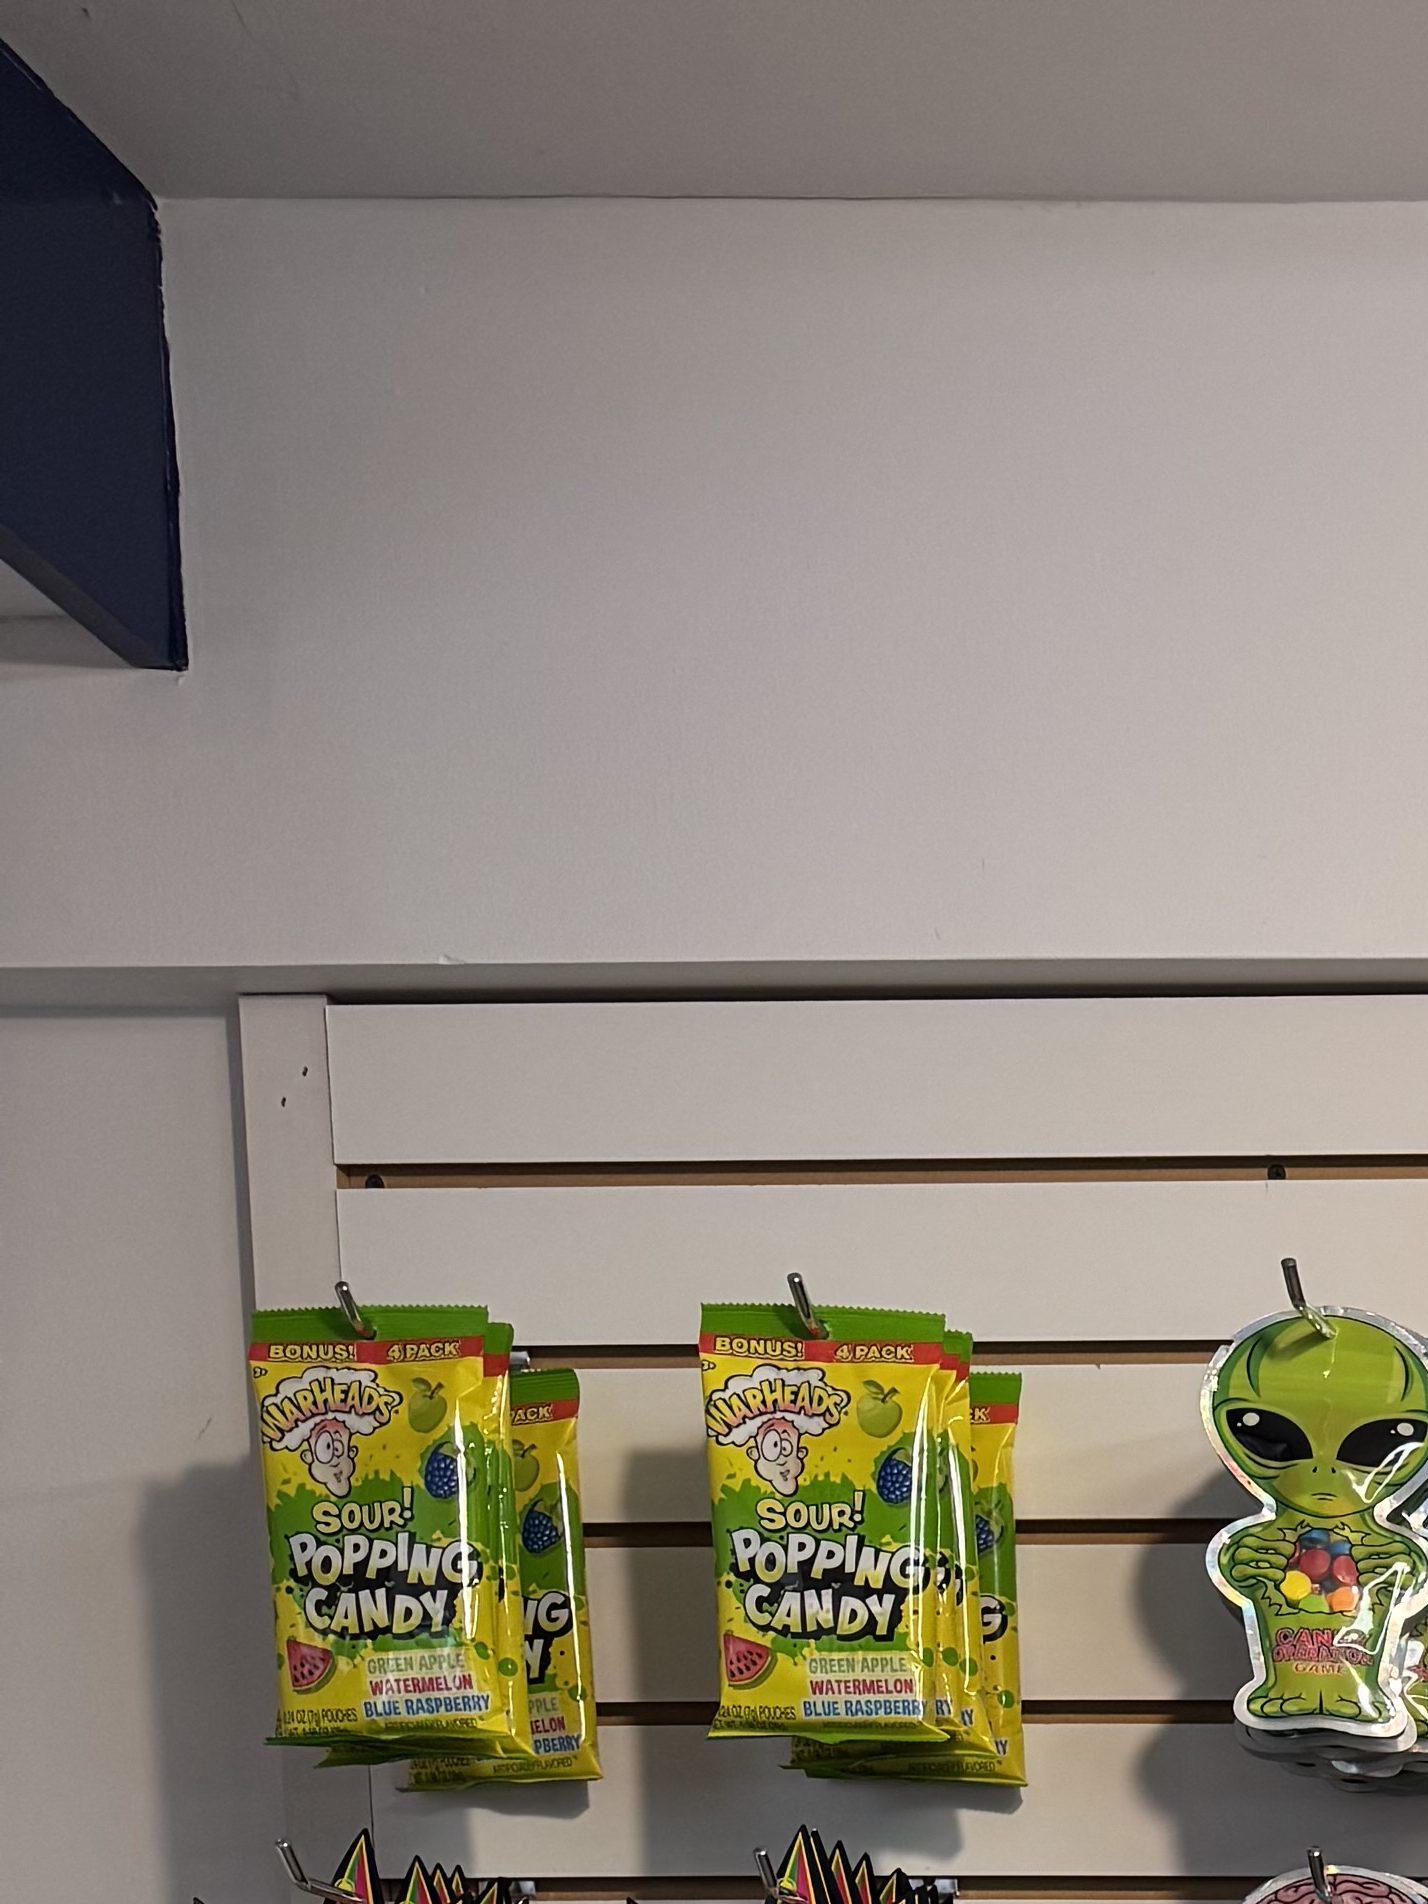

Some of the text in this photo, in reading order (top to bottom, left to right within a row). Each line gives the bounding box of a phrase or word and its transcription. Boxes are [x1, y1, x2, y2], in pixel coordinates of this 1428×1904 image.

[262, 1377, 394, 1444] WARHEADS
[706, 1378, 844, 1437] WARHEADS
[312, 1487, 413, 1533] SOUR!
[756, 1489, 865, 1531] SOUR!
[289, 1532, 479, 1588] POPPING
[731, 1530, 925, 1589] POPPING
[306, 1587, 448, 1636] CANDY
[745, 1585, 896, 1636] CANDY
[367, 1654, 465, 1674] GREEN APPLE
[369, 1674, 474, 1696] WATERMELON
[810, 1679, 916, 1696] WATERMELON
[363, 1694, 490, 1719] BLUE RASPBERRY
